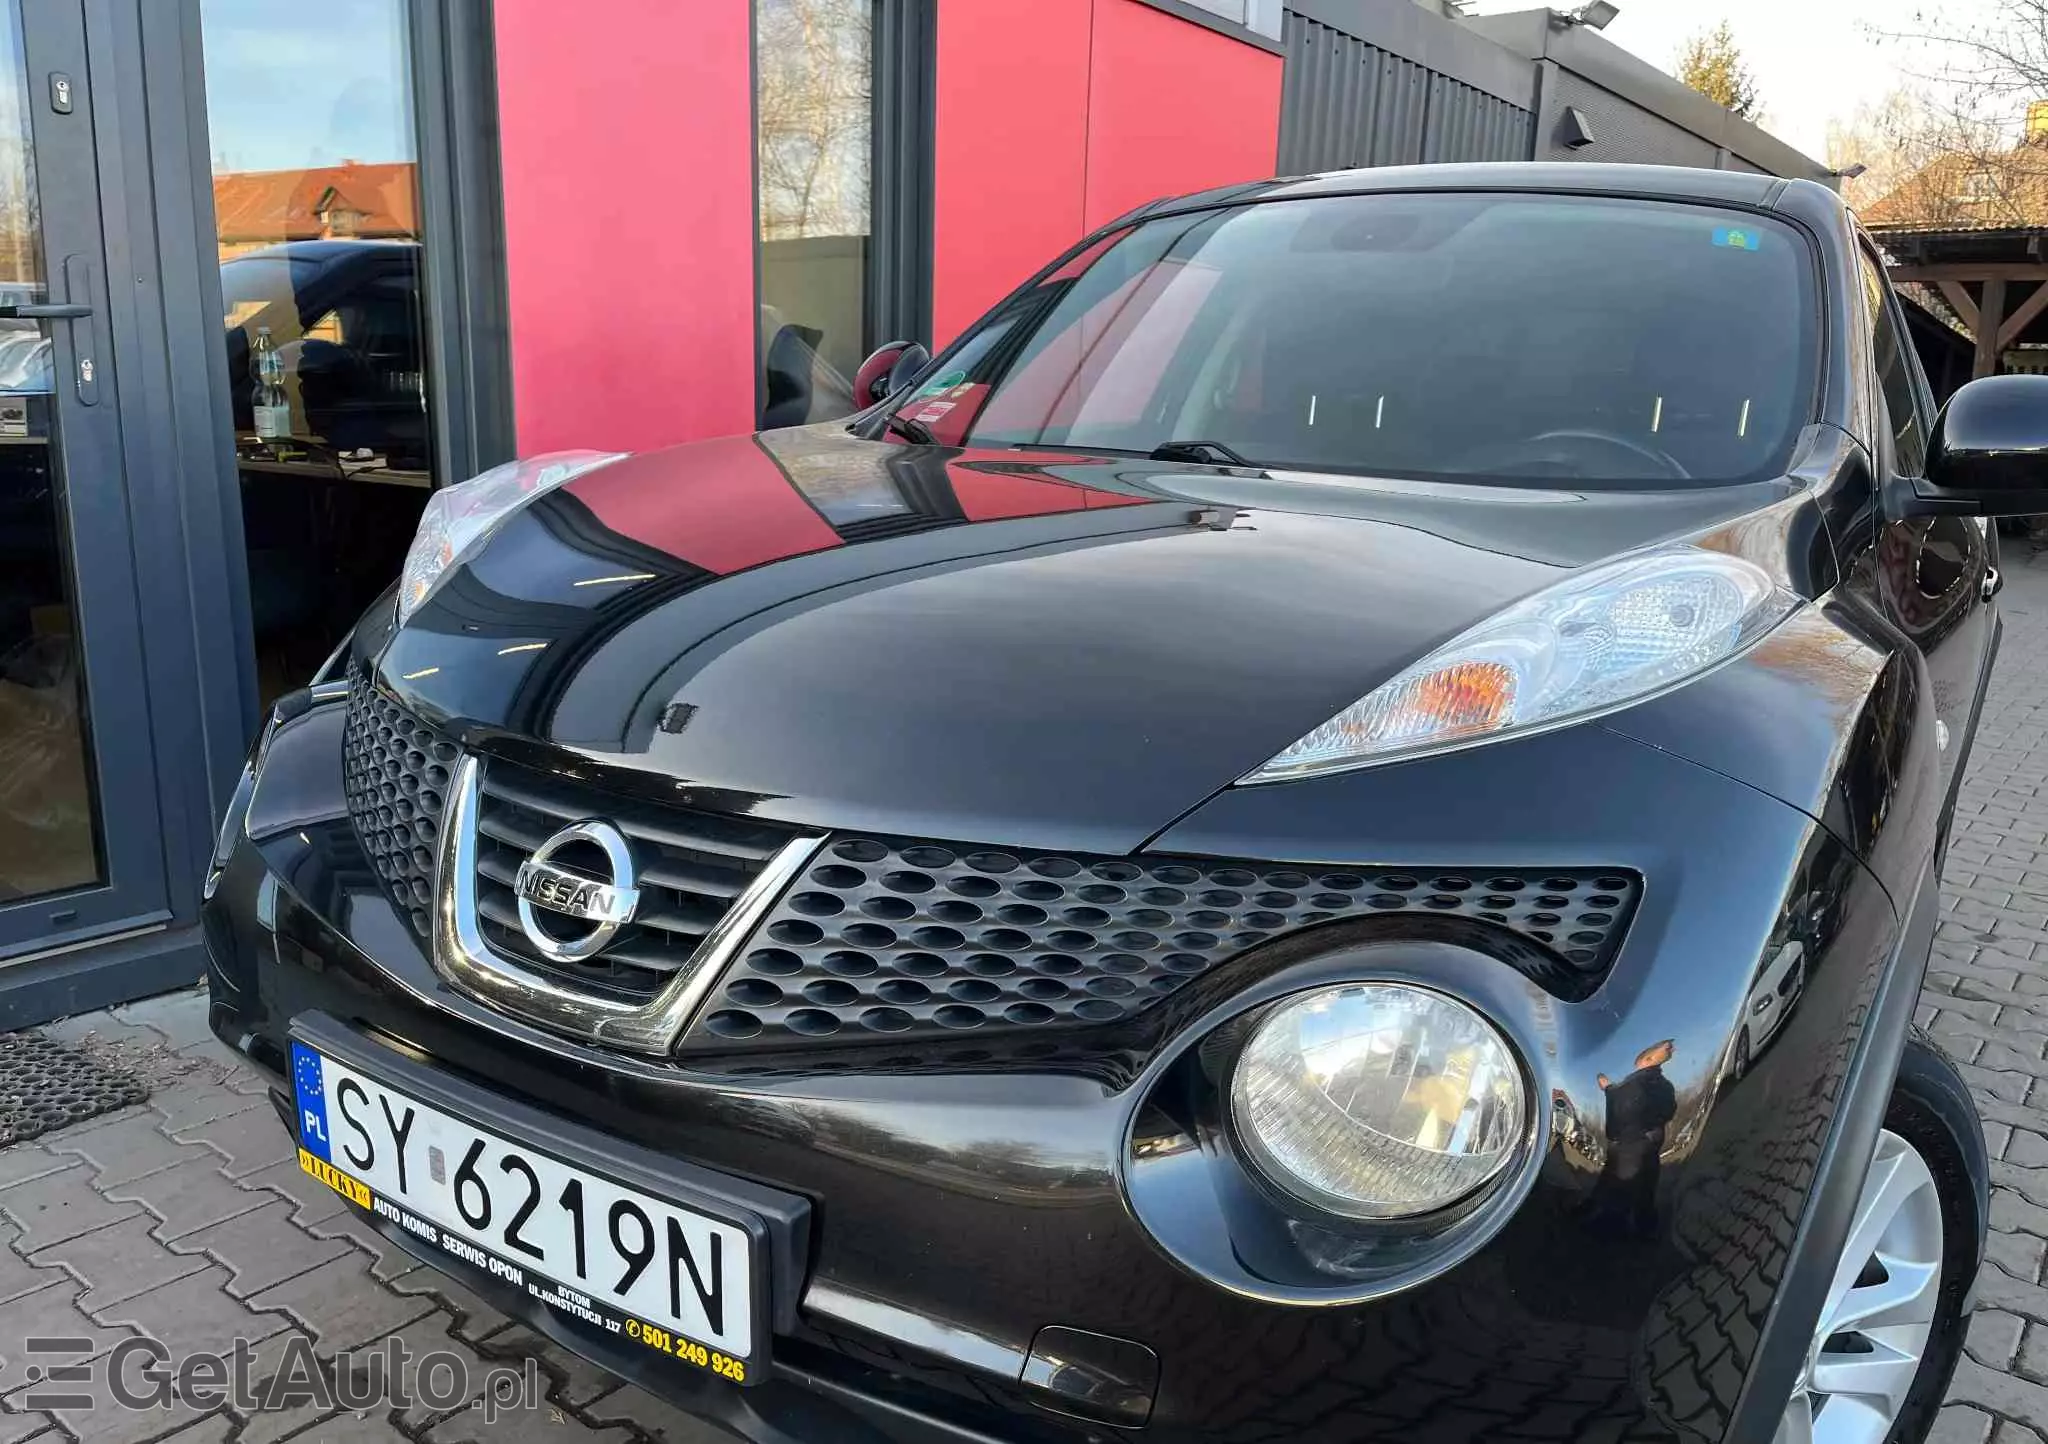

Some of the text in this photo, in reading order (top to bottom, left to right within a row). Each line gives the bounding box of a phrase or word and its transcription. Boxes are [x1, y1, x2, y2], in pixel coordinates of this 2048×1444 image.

[518, 868, 616, 914] NISSAN
[304, 1110, 327, 1142] PL
[337, 1077, 723, 1336] SY 6219N
[374, 1197, 523, 1286] AUTO KOMIS SERWIS OPON
[557, 1285, 591, 1309] BYTOM
[605, 1318, 622, 1333] 117
[642, 1324, 745, 1382] 501 249 926
